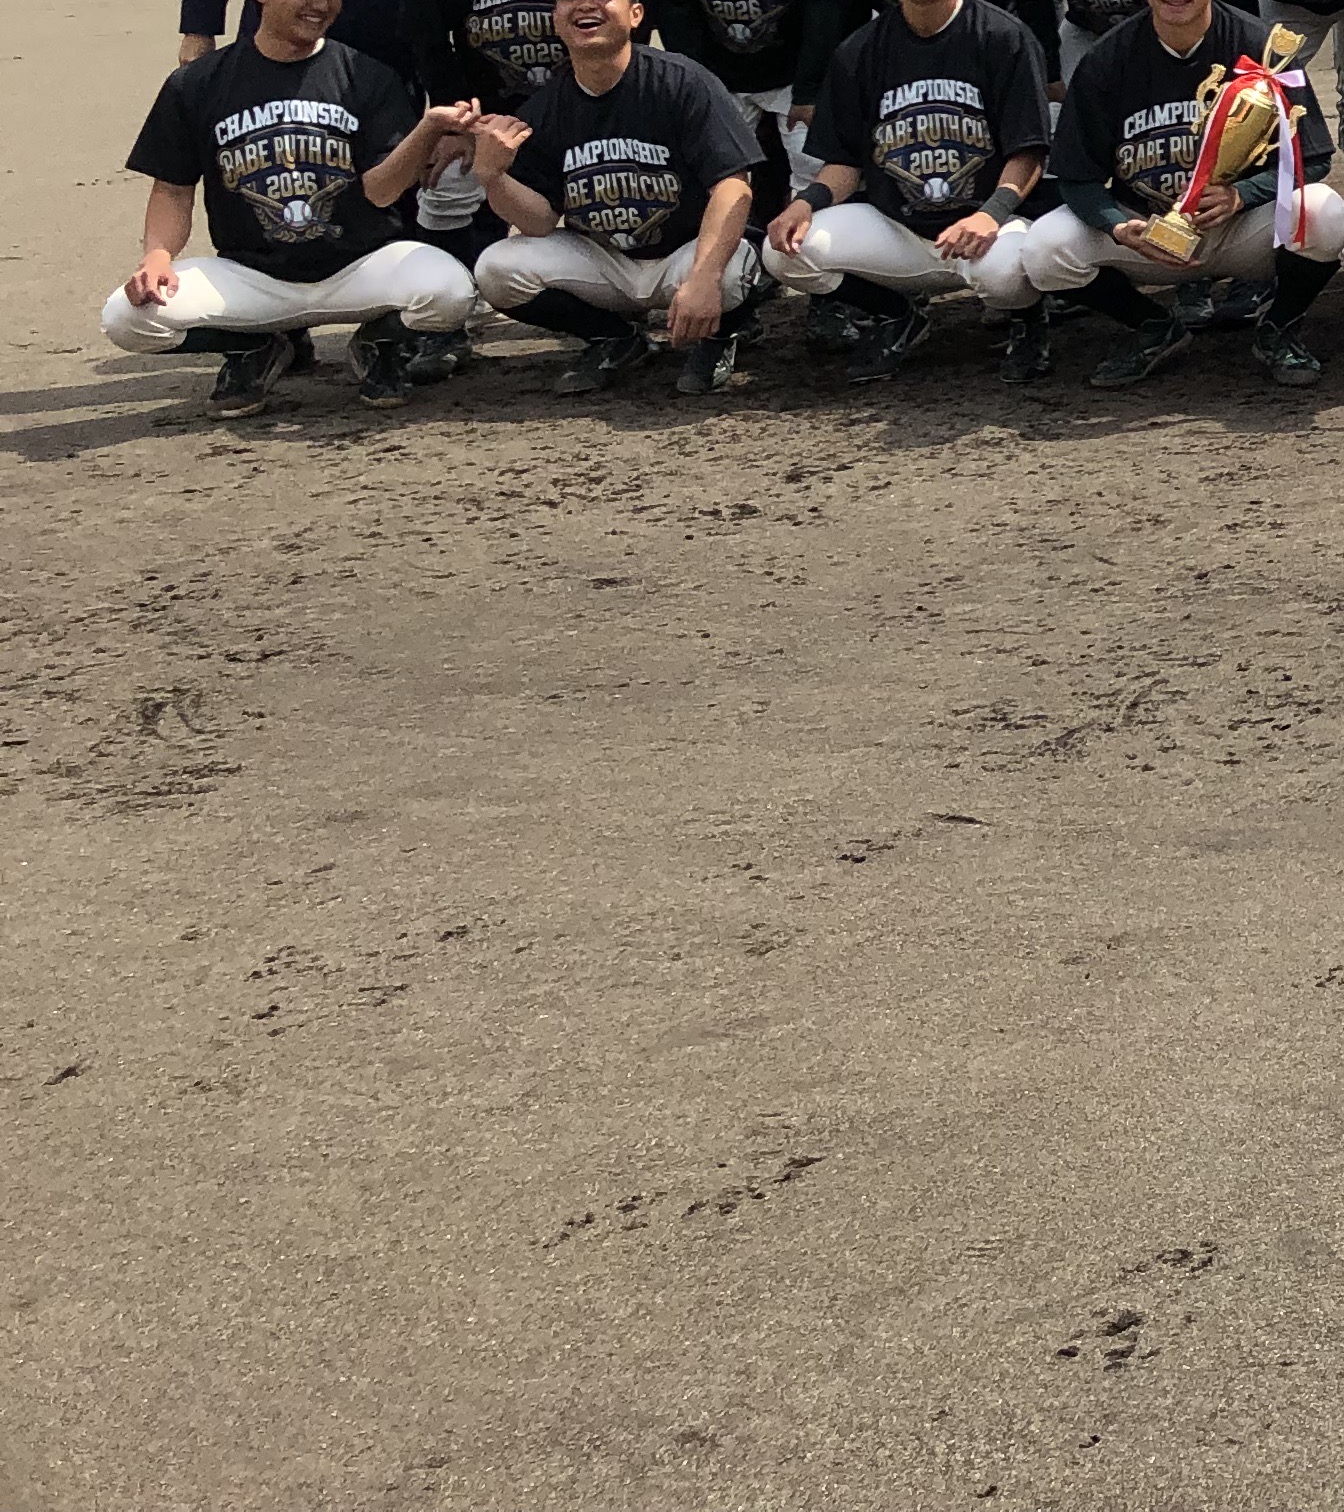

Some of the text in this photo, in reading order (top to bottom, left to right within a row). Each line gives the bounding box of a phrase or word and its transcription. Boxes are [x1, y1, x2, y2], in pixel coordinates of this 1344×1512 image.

[517, 12, 555, 42] RUT
[214, 100, 360, 145] CHAMPIONSHIP
[915, 113, 960, 148] RUTH
[1123, 101, 1201, 139] CHAMPIO
[219, 134, 356, 187] BABE RUTH CU
[563, 138, 671, 171] AMPIONSHIP
[909, 149, 961, 174] 2026
[1118, 139, 1166, 178] BABE
[265, 172, 318, 200] 2026
[593, 173, 639, 202] RUTH
[589, 207, 643, 231] 2026
